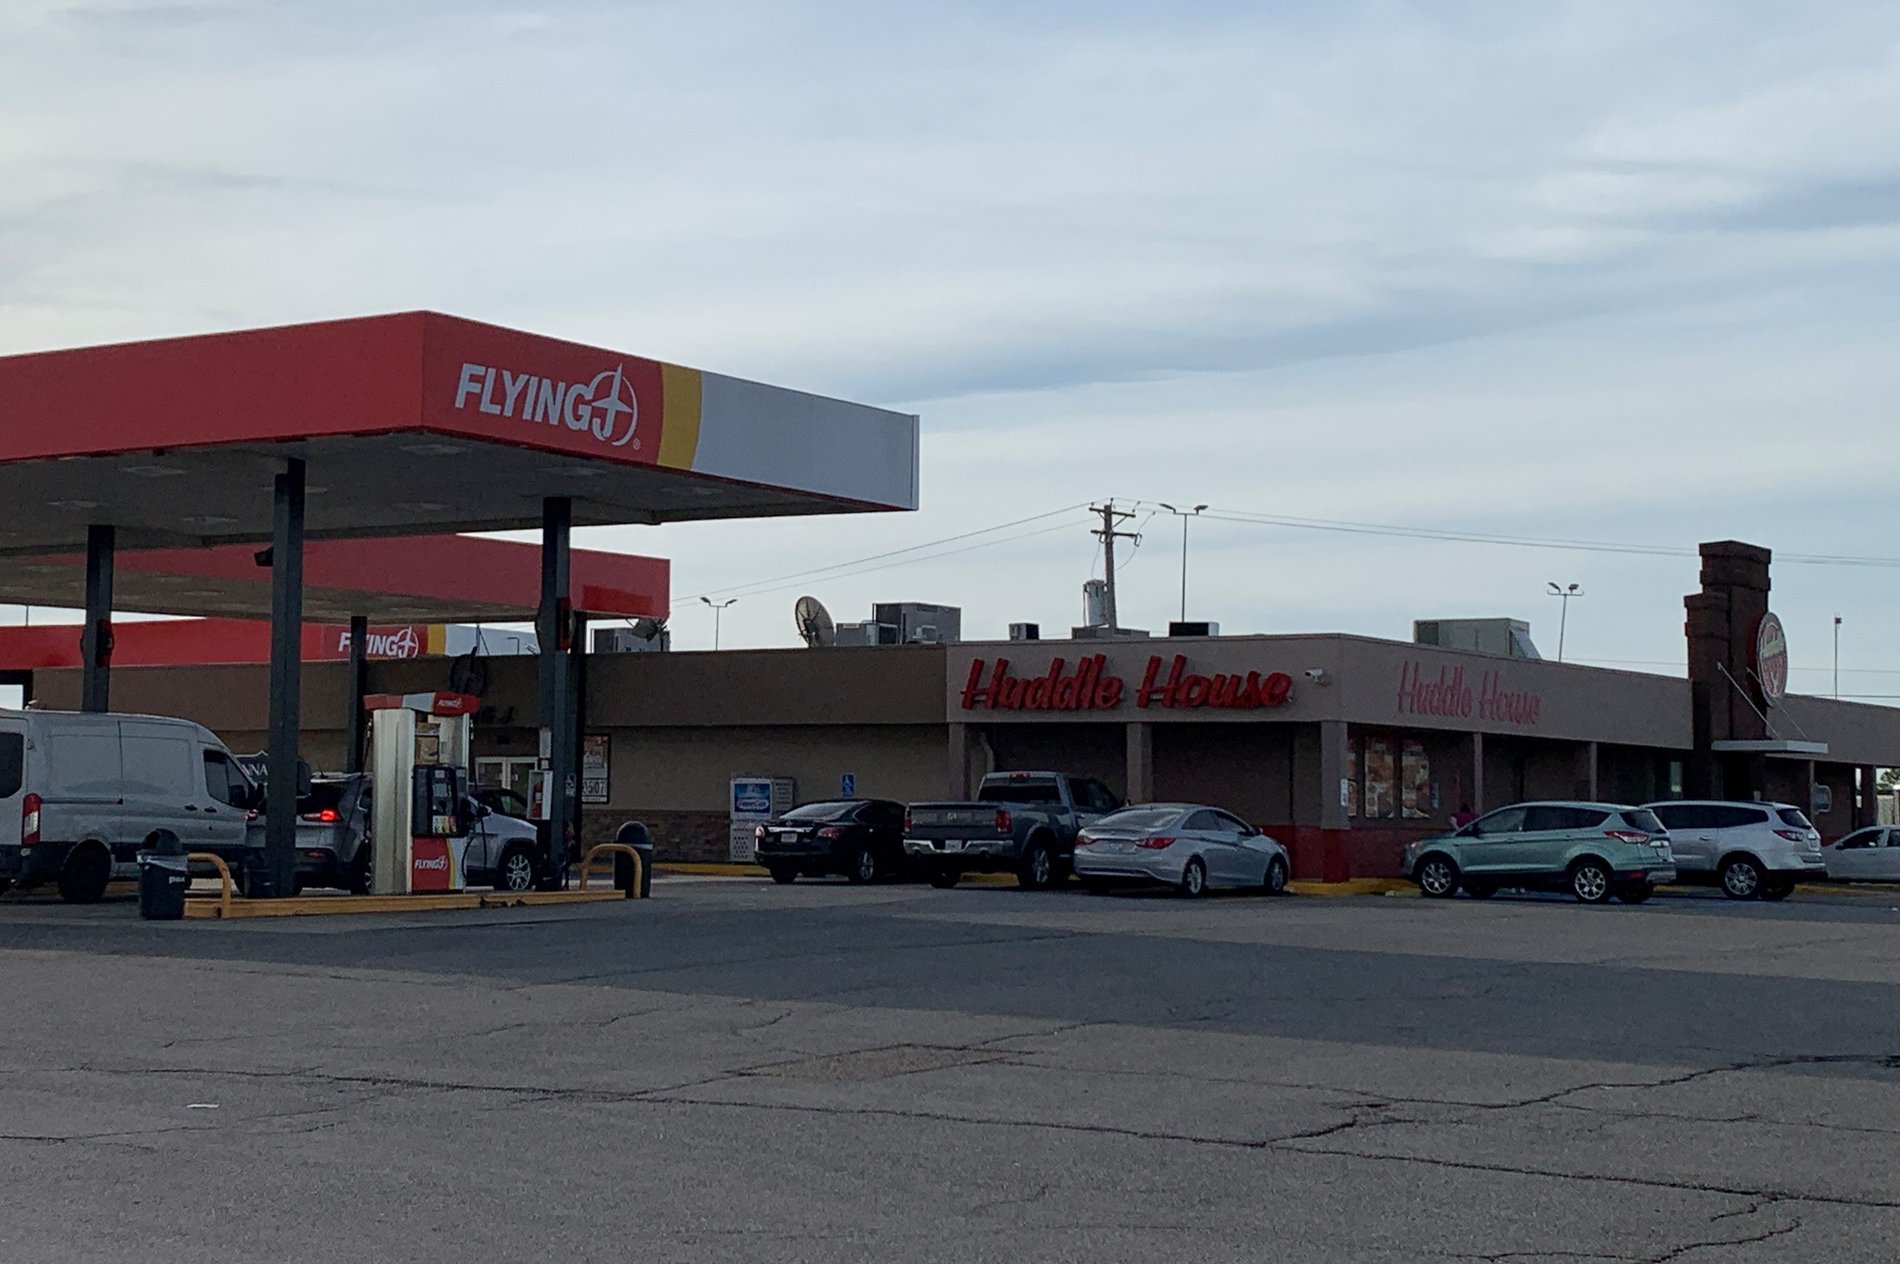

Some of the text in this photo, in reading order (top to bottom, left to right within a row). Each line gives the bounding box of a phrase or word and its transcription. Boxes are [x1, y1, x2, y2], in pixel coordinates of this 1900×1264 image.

[960, 653, 1293, 711] Huddle House
[1397, 660, 1542, 725] Huddle House
